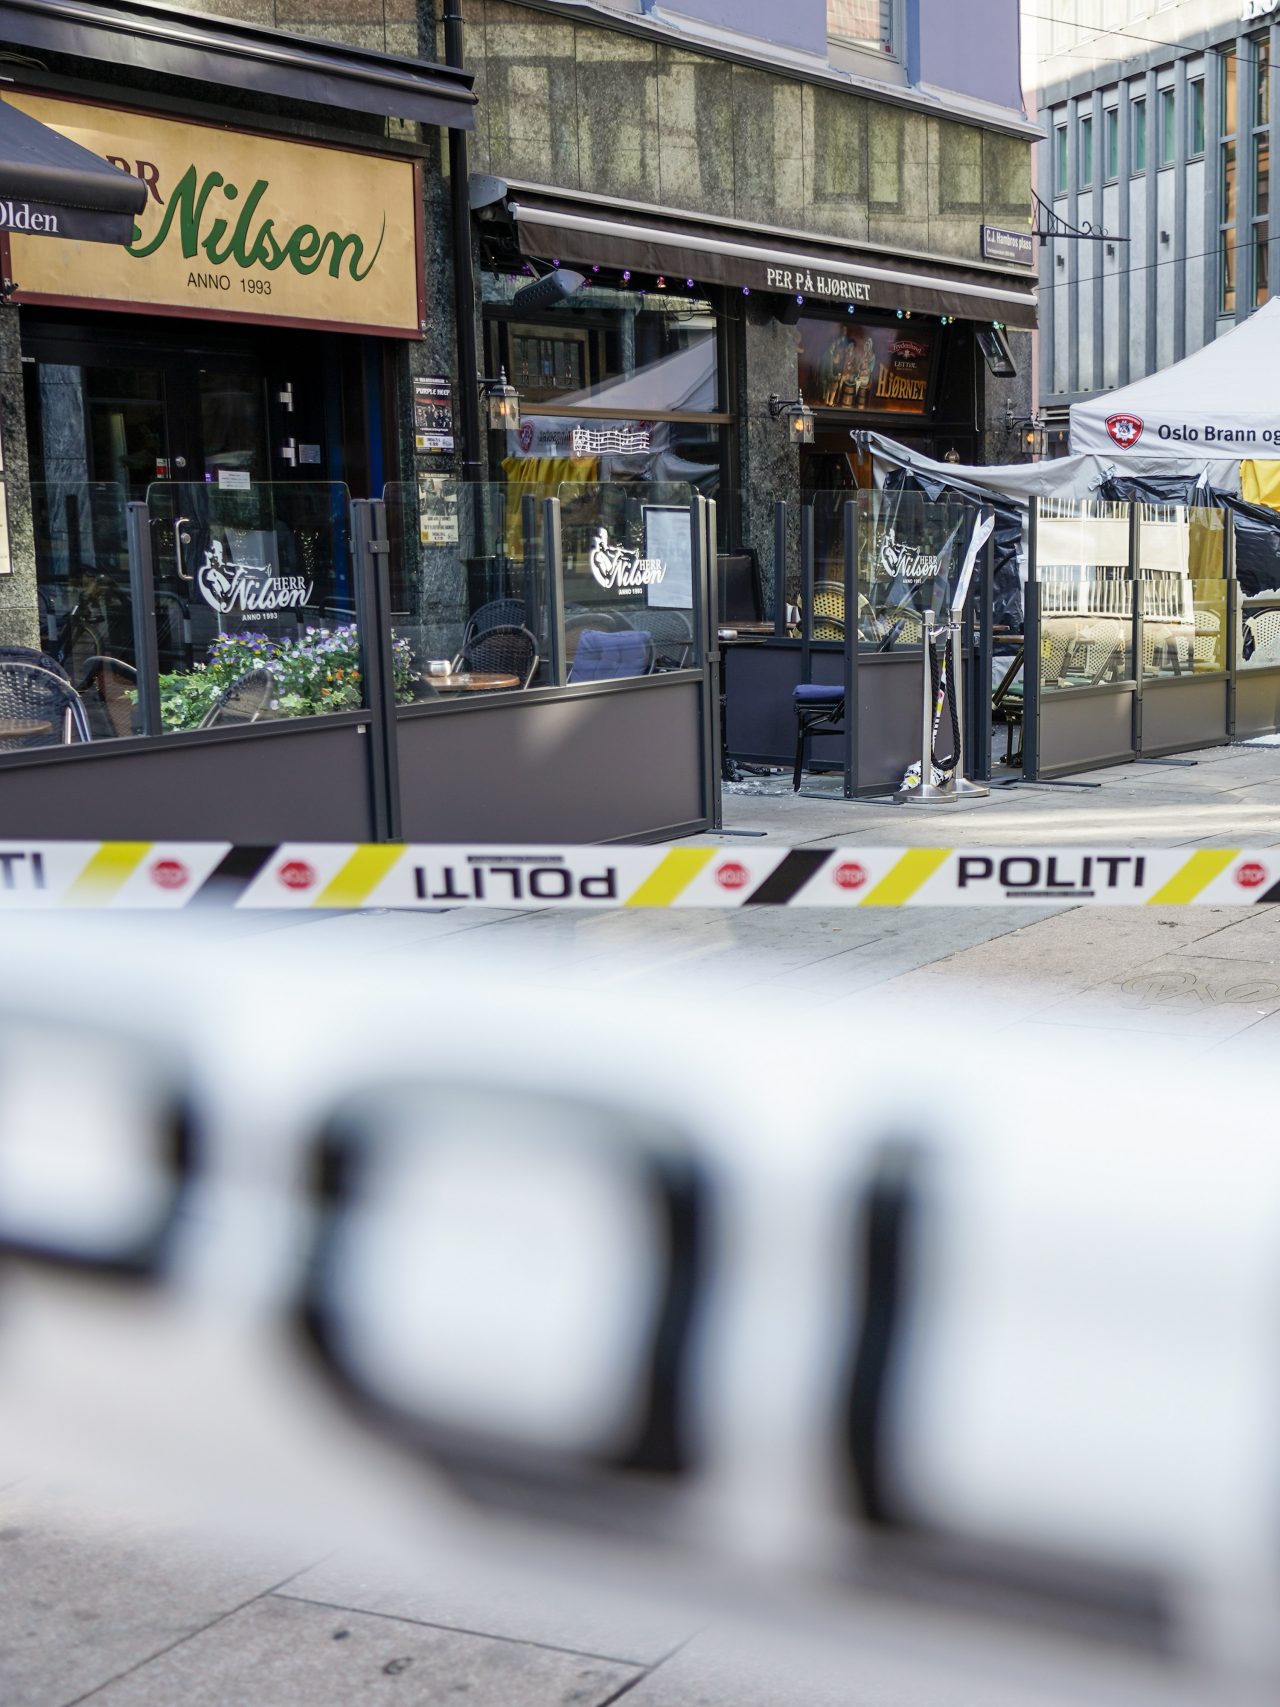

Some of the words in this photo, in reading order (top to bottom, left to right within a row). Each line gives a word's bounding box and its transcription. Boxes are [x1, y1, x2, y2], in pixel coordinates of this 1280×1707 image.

[0, 201, 59, 233] lden
[124, 163, 386, 281] Nilsen
[996, 231, 1018, 248] Hambros
[1018, 237, 1032, 251] plass
[187, 272, 231, 291] ANNO
[240, 279, 272, 295] 1993
[767, 268, 793, 290] PER
[796, 270, 815, 292] PÅ
[817, 276, 871, 300] HJØRNET
[1158, 424, 1198, 441] Oslo
[1204, 425, 1256, 442] Brann
[640, 558, 661, 571] HERR
[892, 554, 942, 577] Nilsen
[919, 555, 938, 565] HERR
[272, 576, 306, 591] HERR
[606, 558, 666, 588] Nilsen
[220, 577, 314, 614] Nilsen
[242, 613, 261, 621] ANNO
[262, 612, 278, 620] 1993
[414, 867, 617, 900] POLITI
[957, 856, 1145, 888] POLITI
